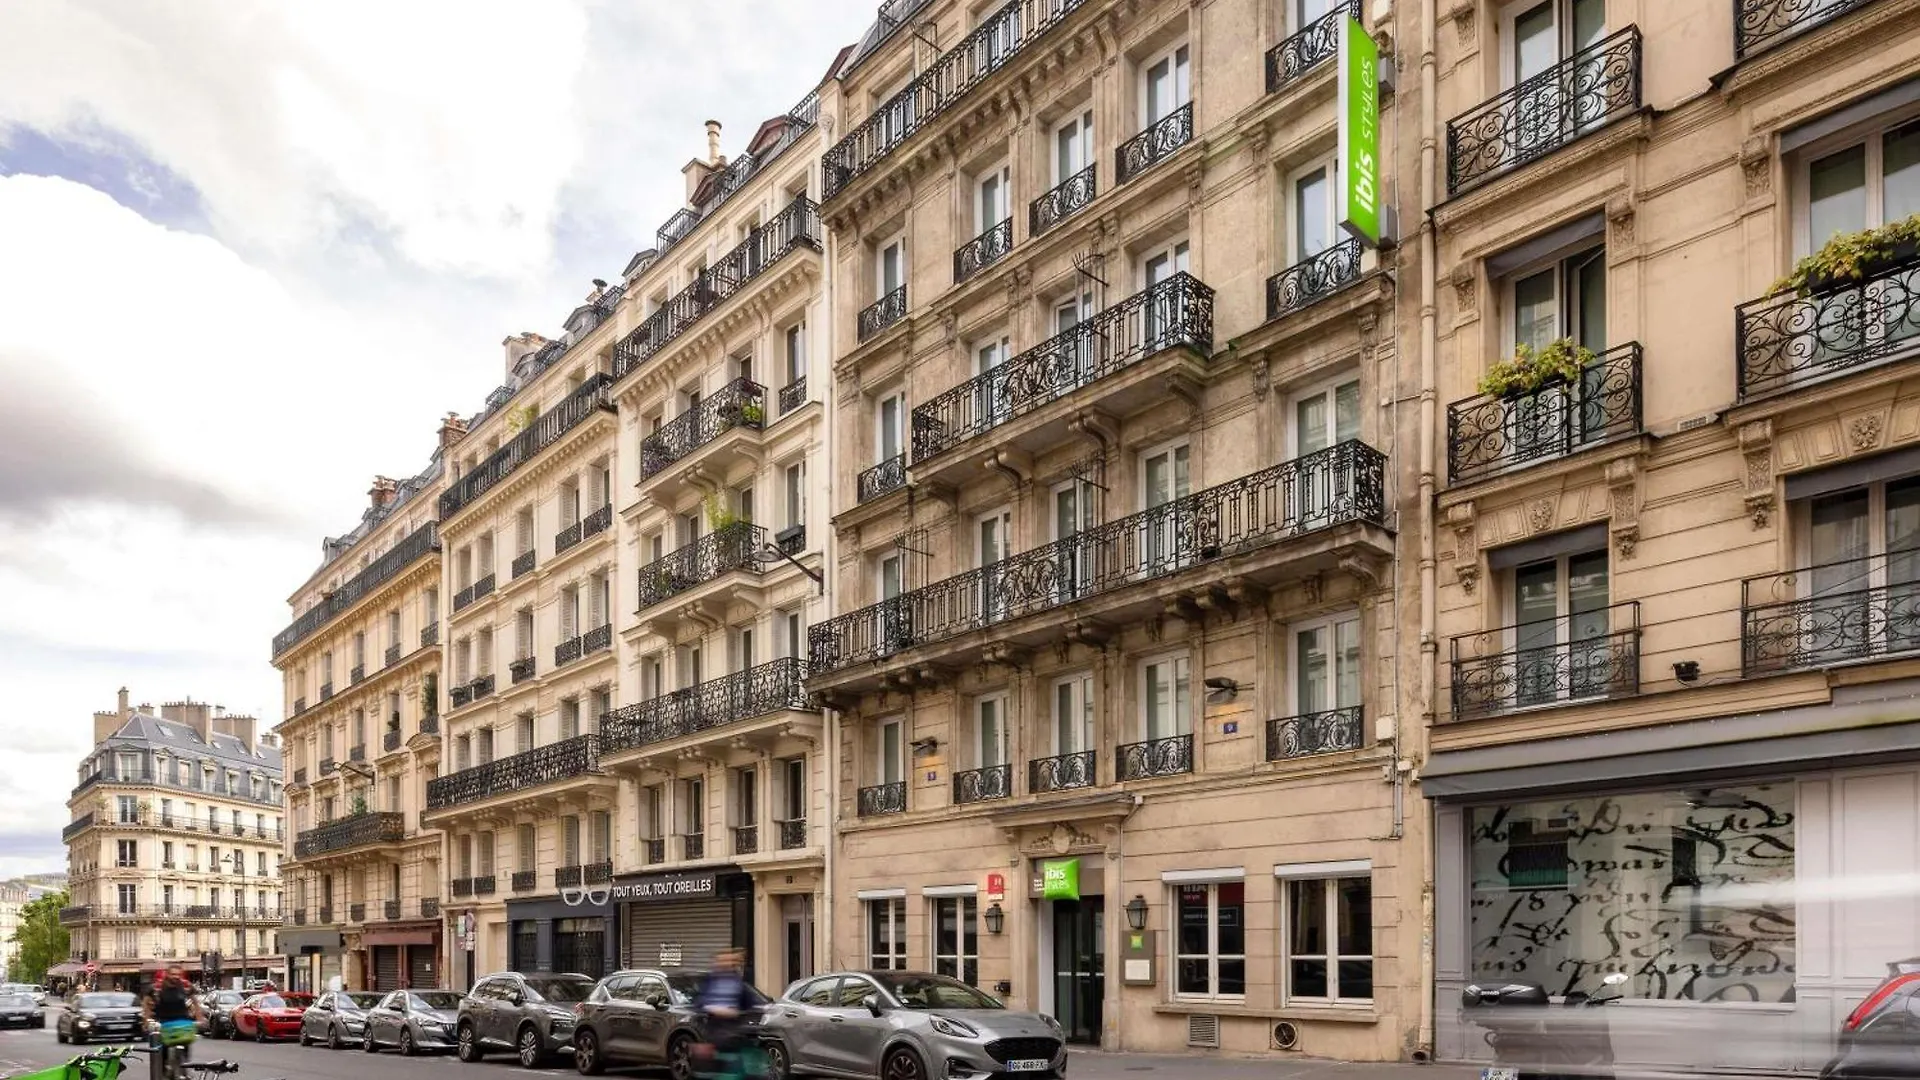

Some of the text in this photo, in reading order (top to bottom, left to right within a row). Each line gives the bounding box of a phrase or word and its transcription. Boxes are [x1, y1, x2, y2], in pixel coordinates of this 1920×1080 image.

[1355, 149, 1374, 215] ibis
[1046, 867, 1066, 880] ibis
[613, 885, 631, 898] TOUT
[653, 881, 673, 895] TOUT
[674, 879, 711, 894] OREILLES
